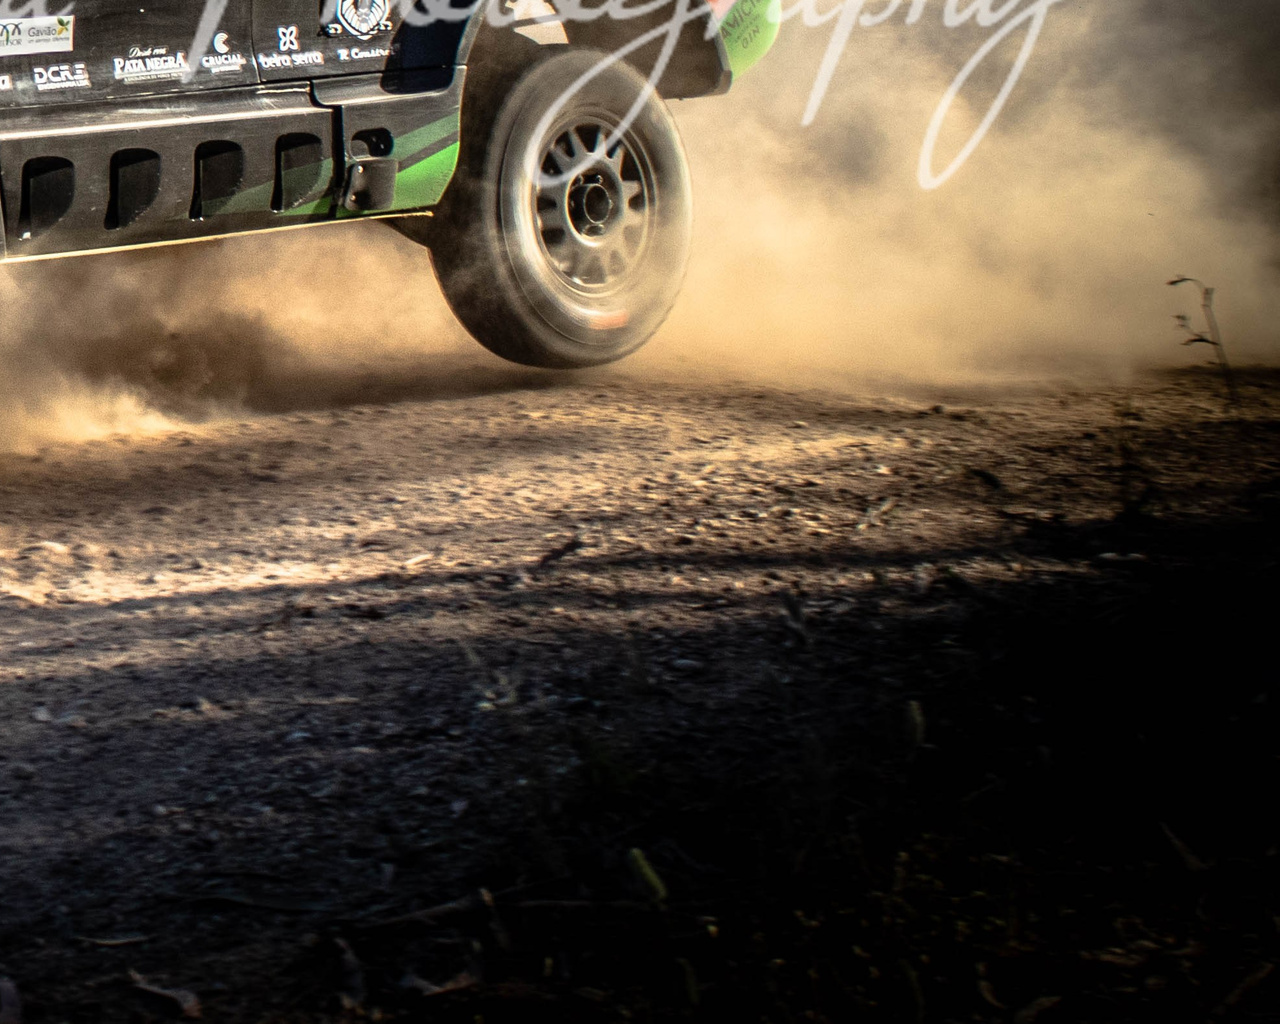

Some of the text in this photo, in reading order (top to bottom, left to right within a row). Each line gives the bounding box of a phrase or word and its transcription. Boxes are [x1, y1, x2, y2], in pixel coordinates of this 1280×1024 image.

[28, 26, 57, 37] Gavião
[113, 57, 146, 74] PATA
[145, 51, 188, 71] NEGRA
[202, 53, 245, 66] CRUCIAL
